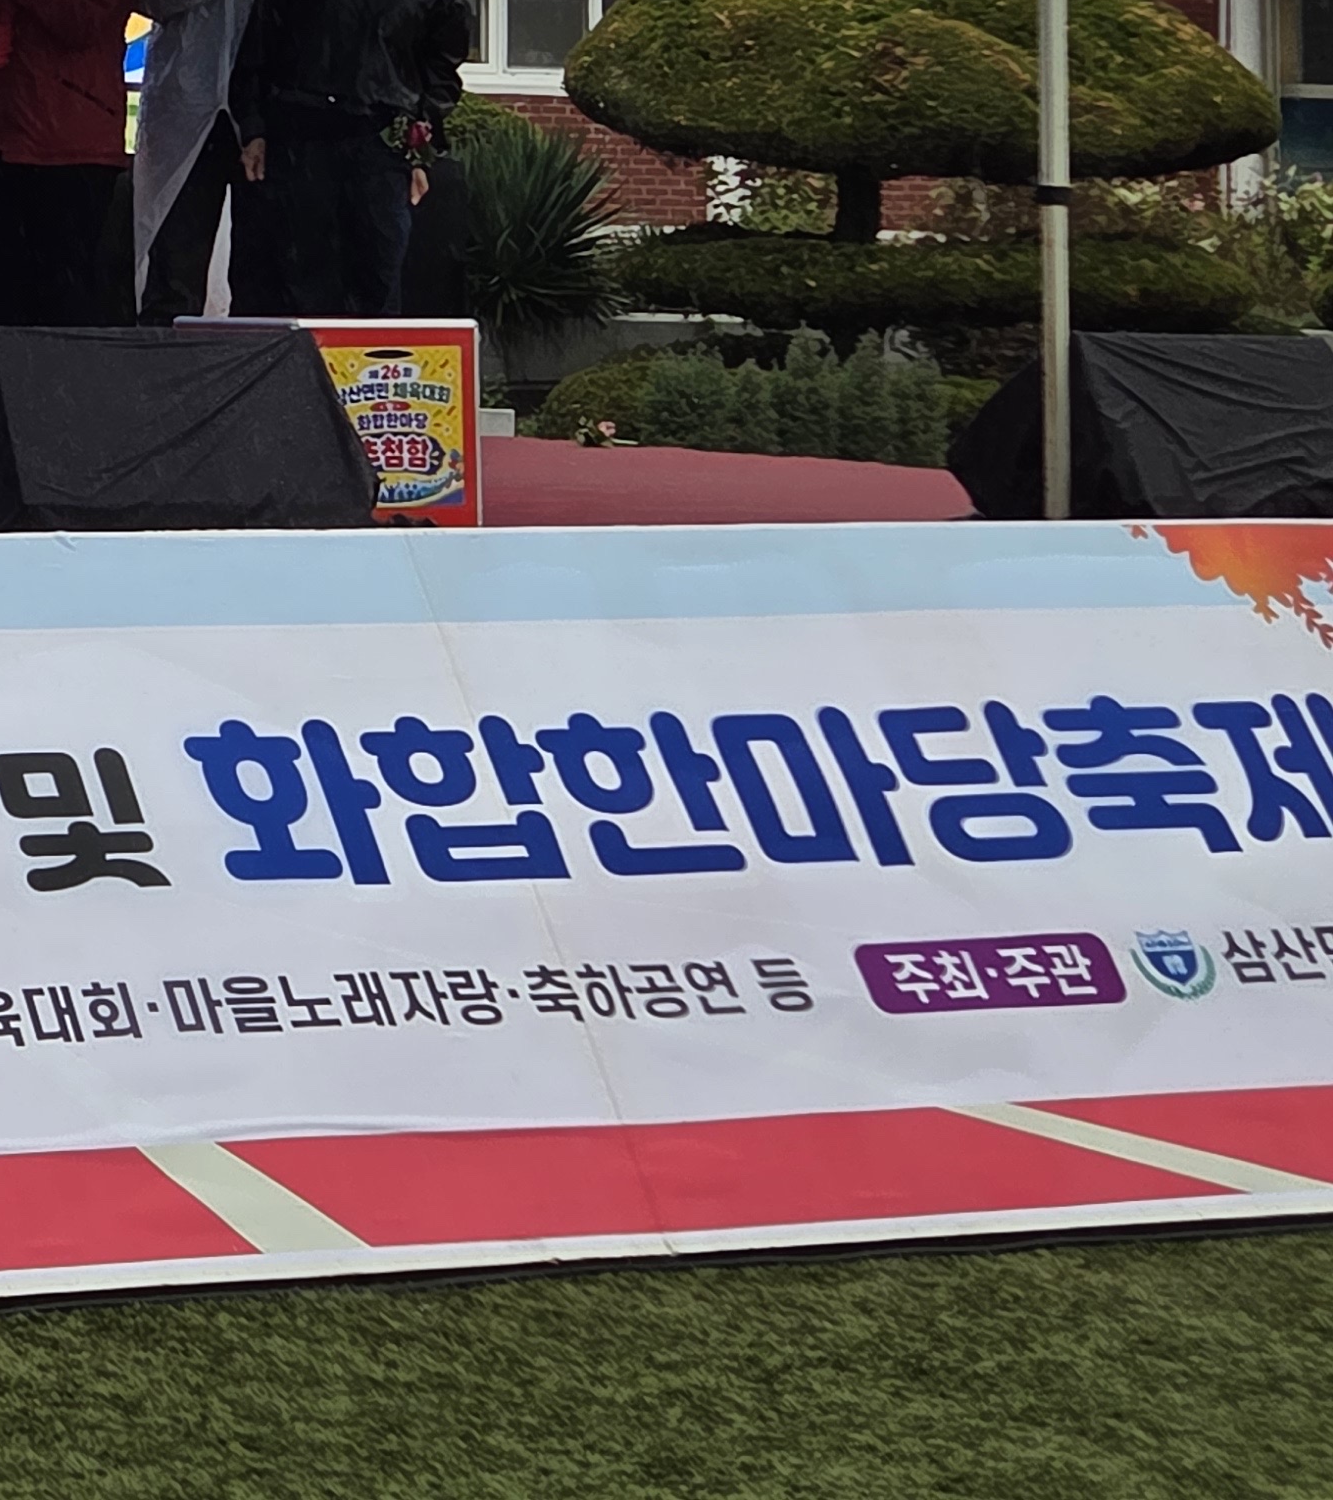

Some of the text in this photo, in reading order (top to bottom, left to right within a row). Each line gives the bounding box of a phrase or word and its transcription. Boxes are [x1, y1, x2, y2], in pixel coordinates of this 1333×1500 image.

[183, 692, 1333, 886] 화합한마당축제
[750, 957, 815, 1013] 등
[891, 943, 1099, 1003] 주최·주관
